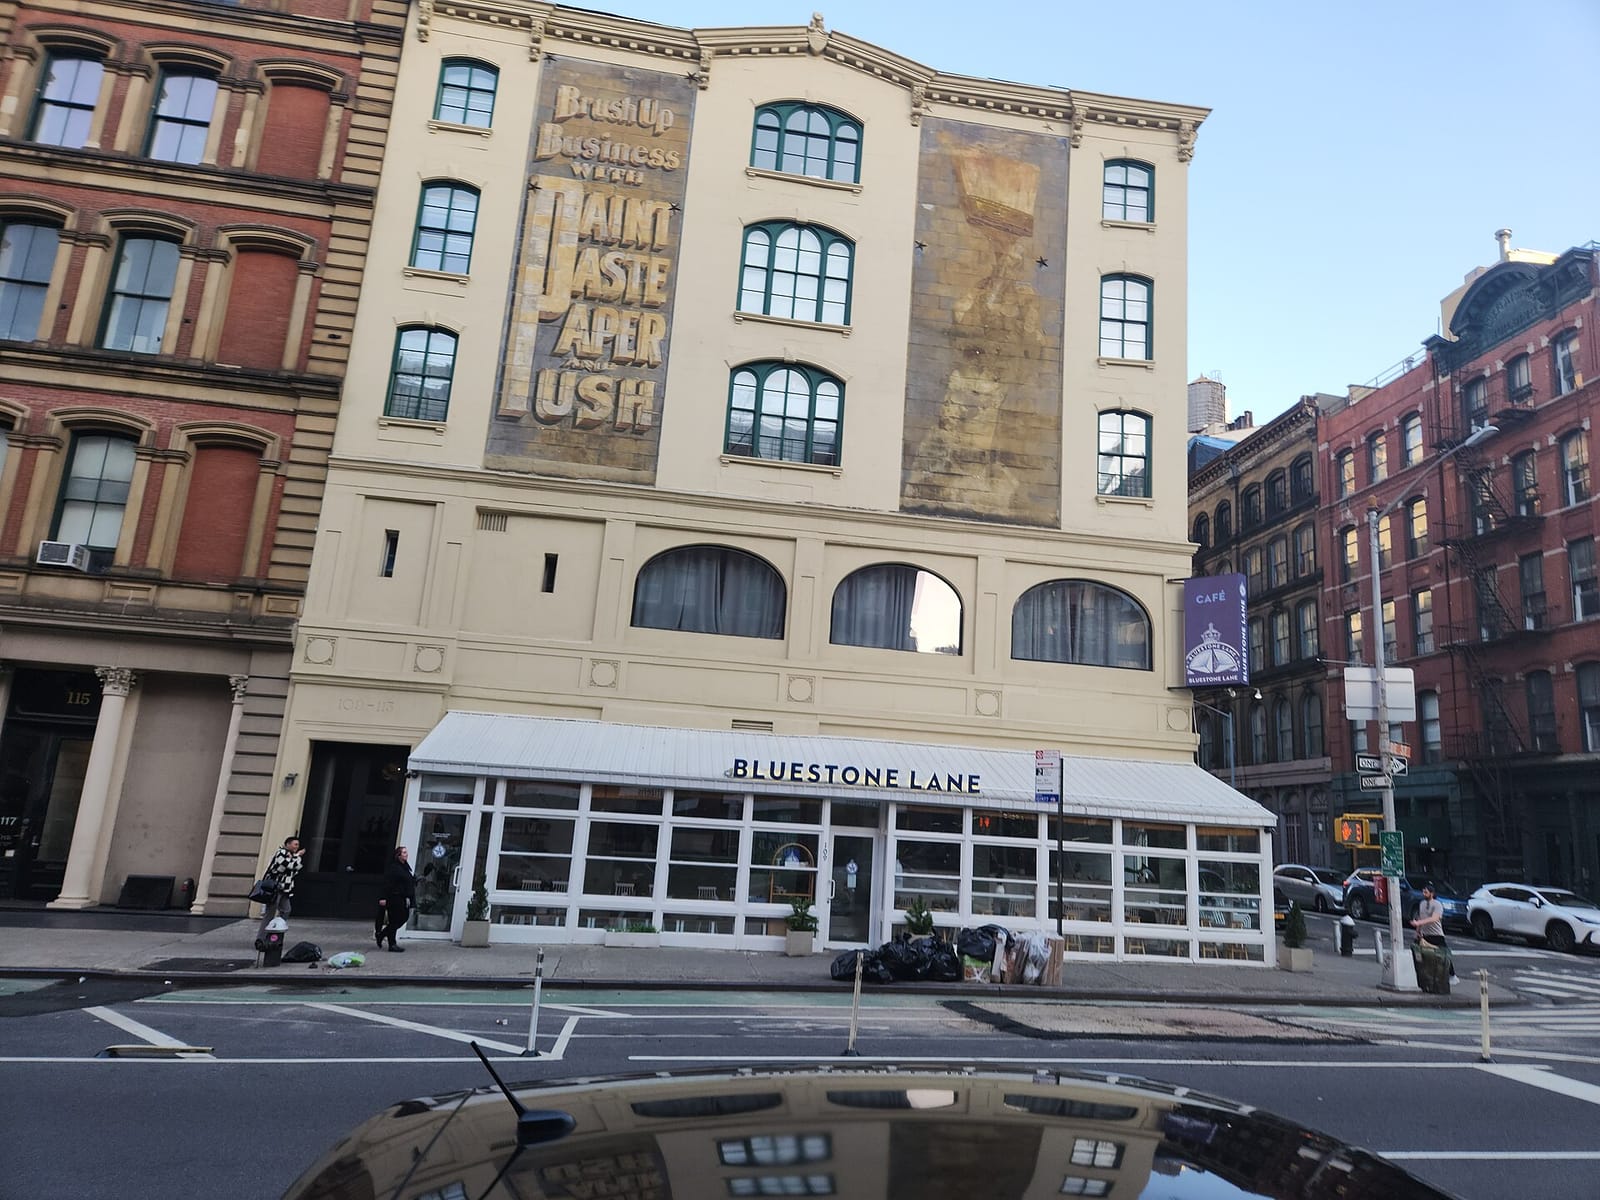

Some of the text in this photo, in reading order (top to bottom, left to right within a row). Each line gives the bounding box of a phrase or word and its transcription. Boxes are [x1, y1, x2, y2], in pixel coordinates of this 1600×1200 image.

[534, 122, 681, 171] Business
[570, 162, 644, 186] WITH
[1196, 590, 1226, 604] CAFÉ
[65, 691, 91, 705] 115
[733, 758, 981, 793] BLUESTONE LANE
[0, 816, 17, 826] 117
